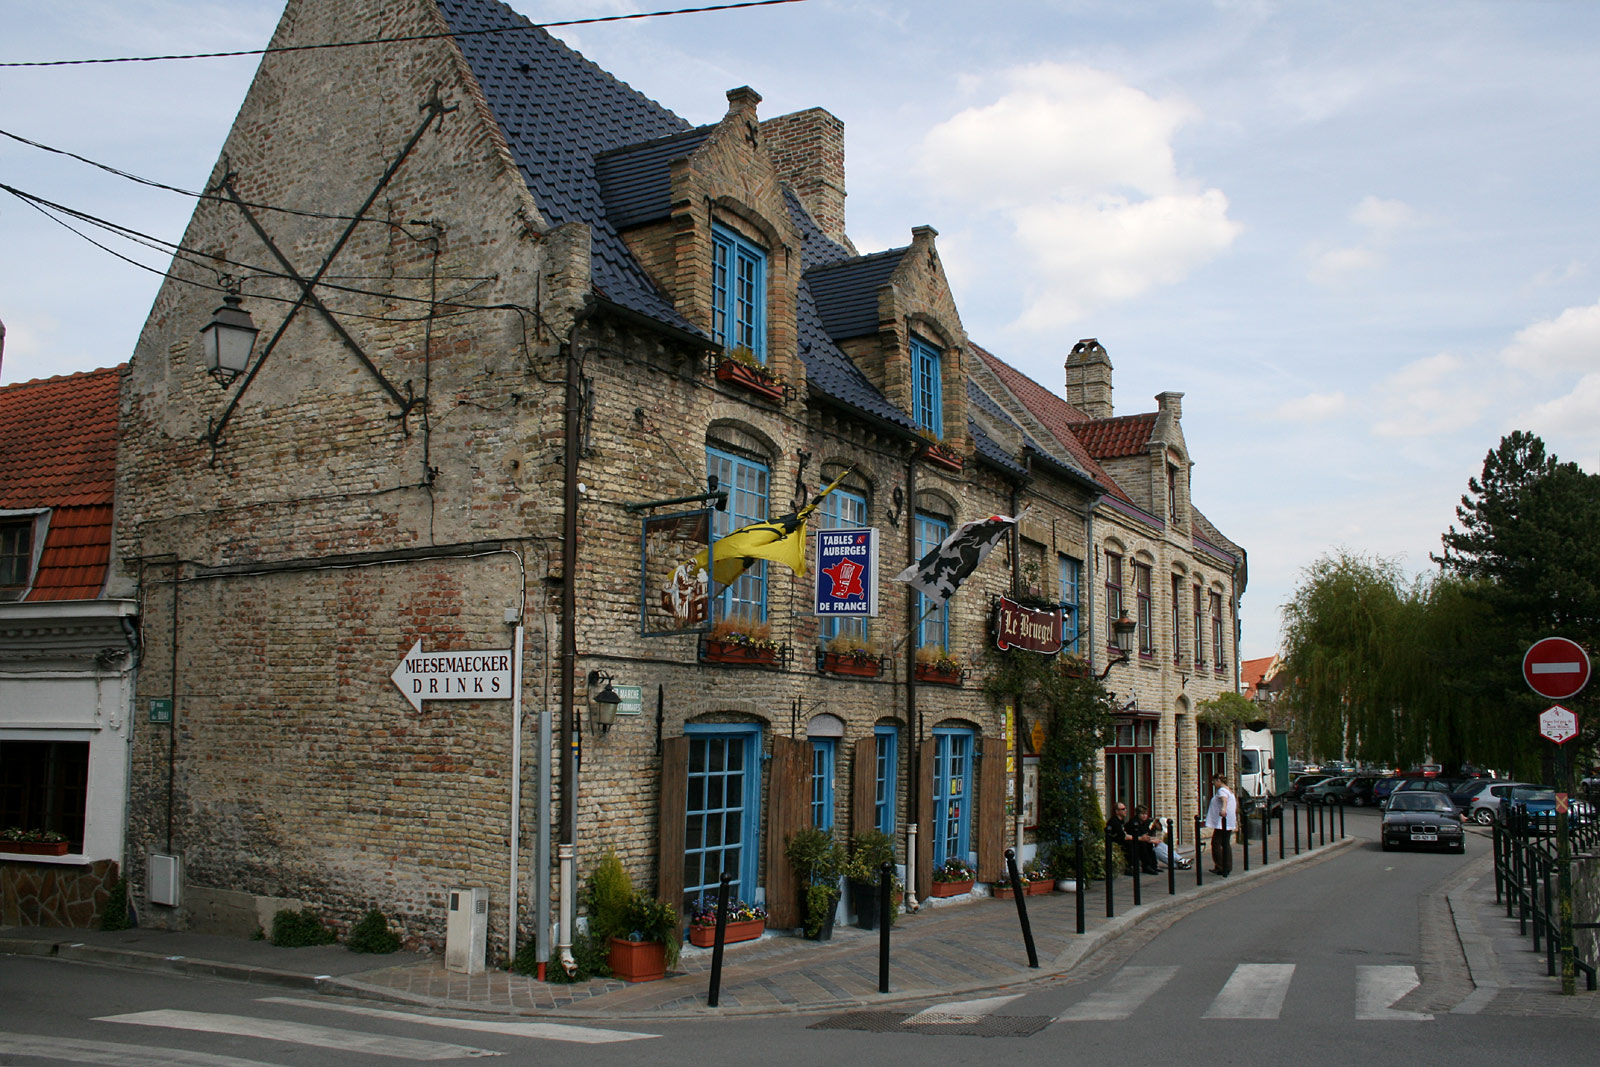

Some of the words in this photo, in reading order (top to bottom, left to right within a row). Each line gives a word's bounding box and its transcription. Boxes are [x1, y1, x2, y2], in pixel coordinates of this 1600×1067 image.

[823, 535, 853, 546] TABLES
[823, 546, 867, 557] AUBERGES
[820, 602, 831, 611] DE
[833, 602, 867, 611] FRANCE
[1004, 609, 1018, 636] Le
[1020, 613, 1054, 645] Bruegel
[405, 655, 509, 674] MEESEMAECKER
[413, 676, 501, 694] DRINKS
